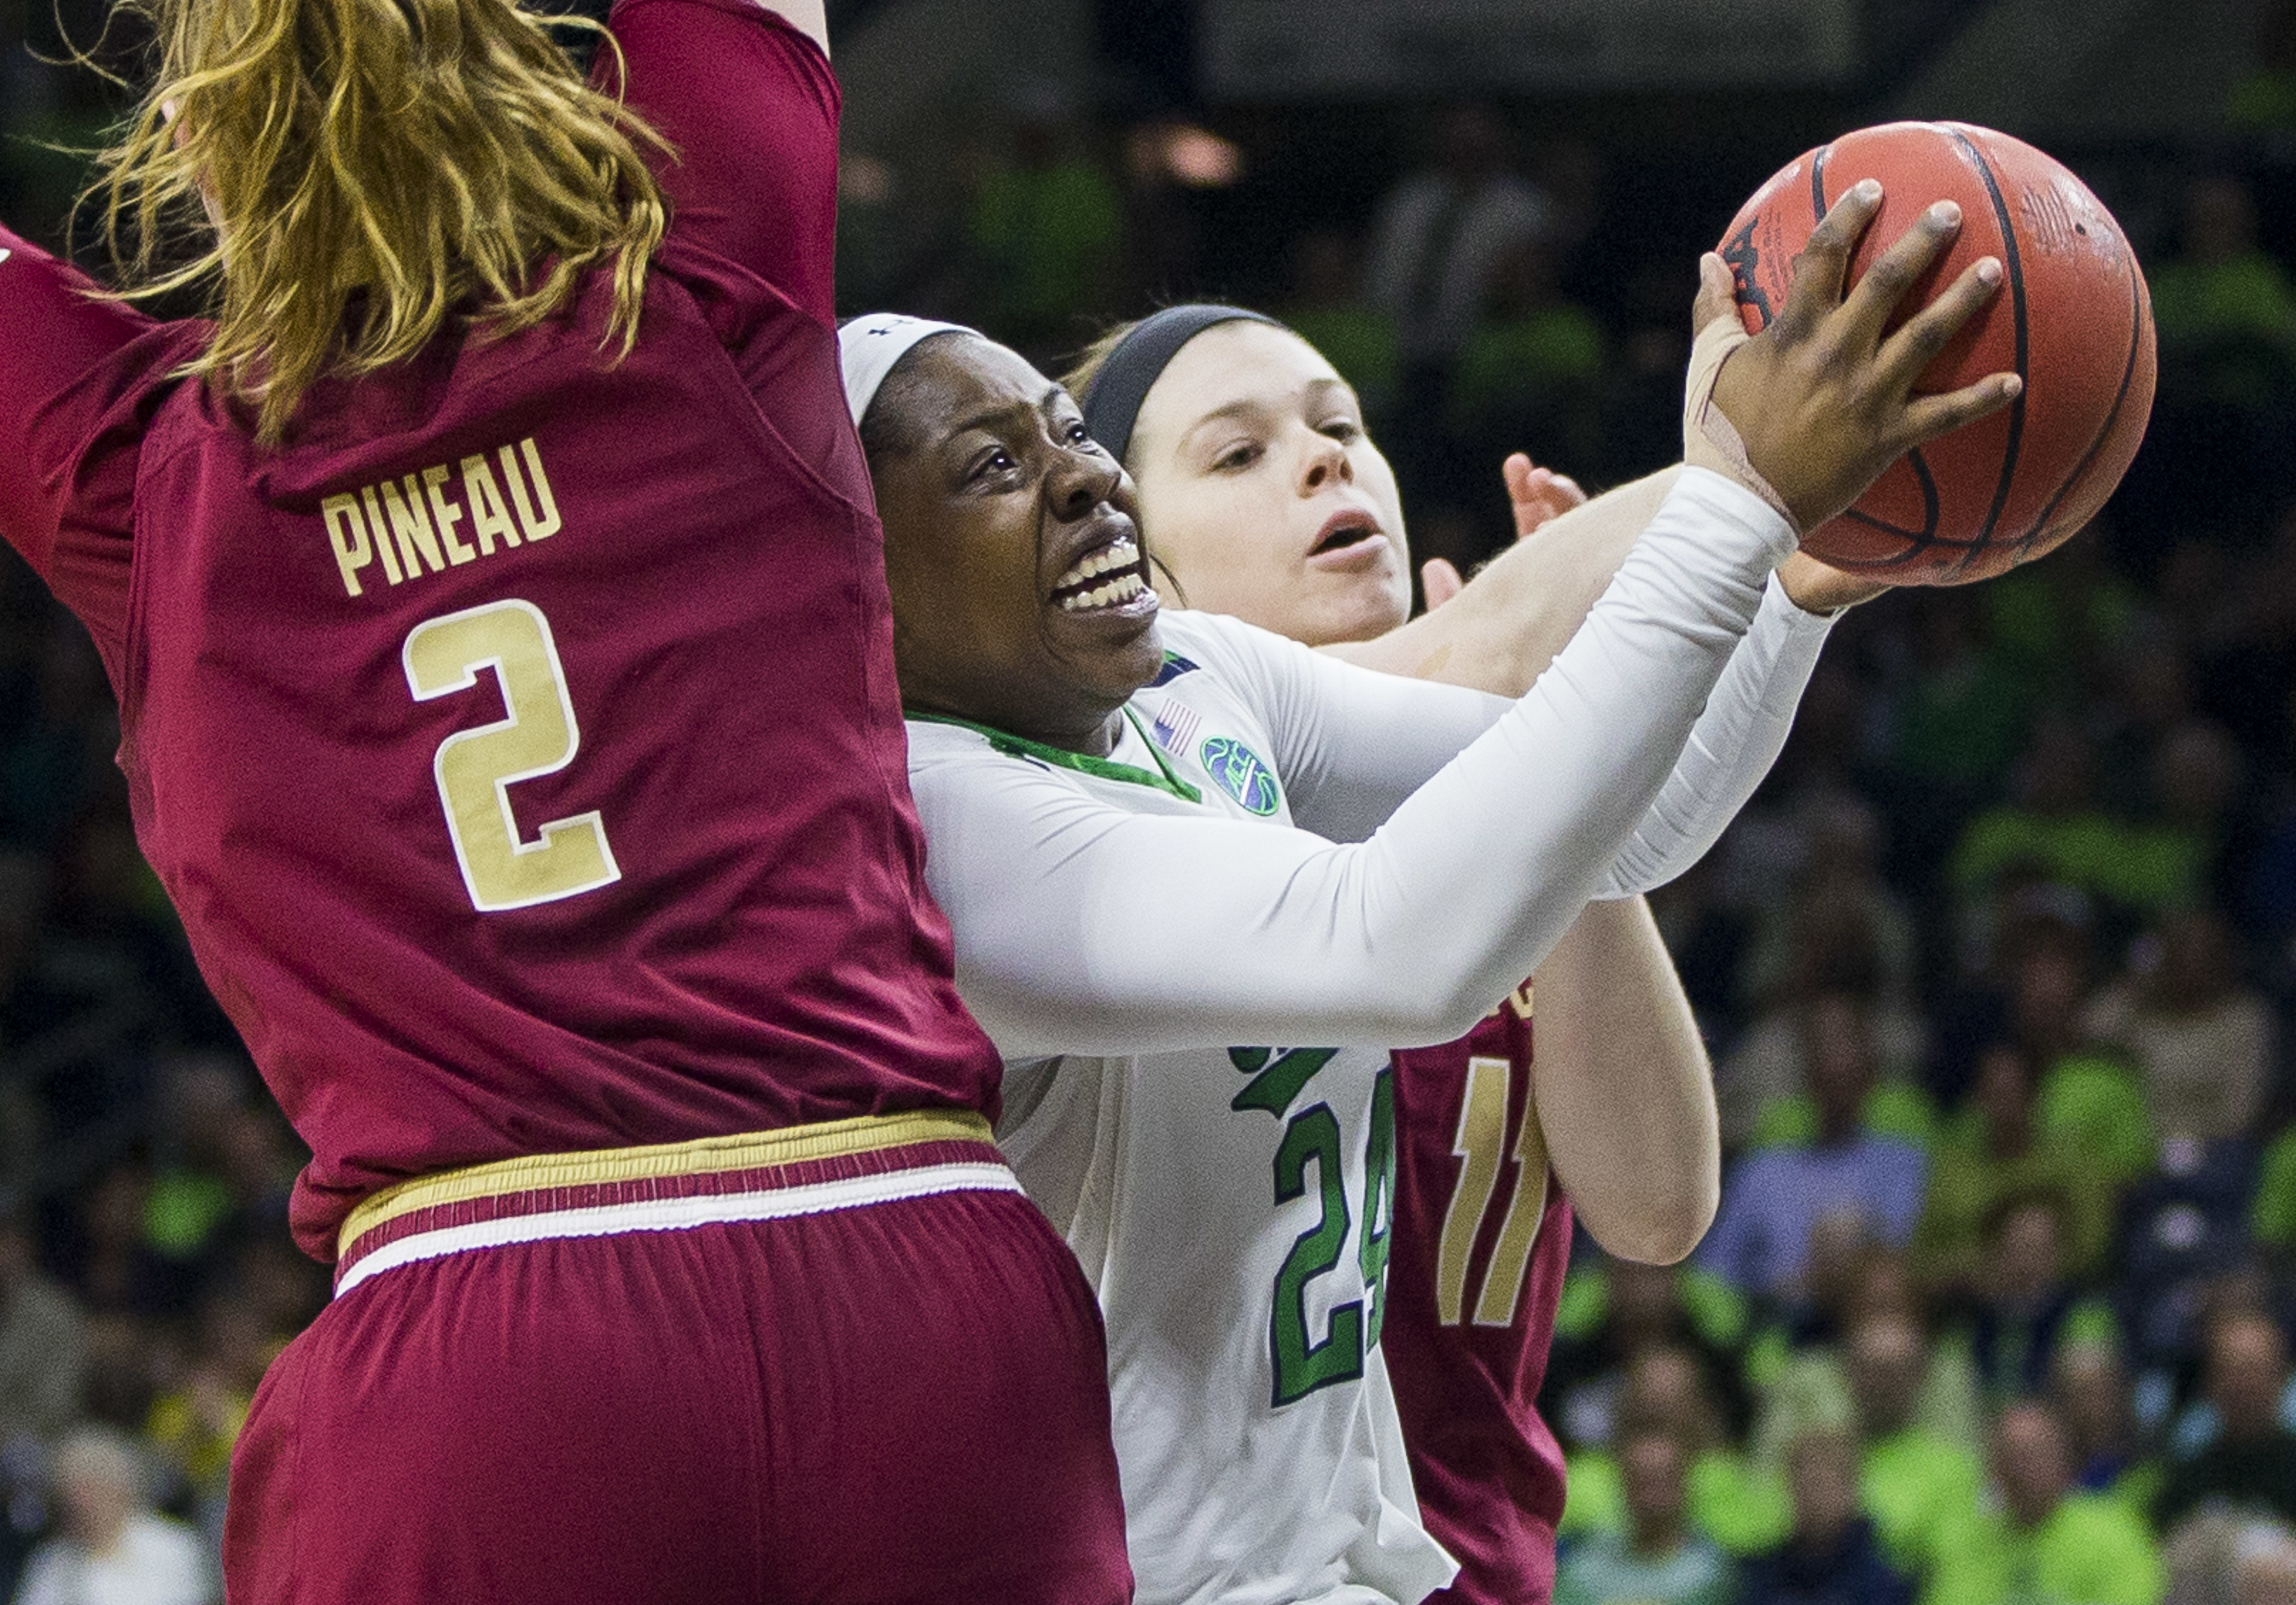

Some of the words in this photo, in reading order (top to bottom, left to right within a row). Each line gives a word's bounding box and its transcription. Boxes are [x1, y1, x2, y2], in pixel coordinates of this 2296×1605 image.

[321, 438, 562, 597] PINEAU
[402, 598, 622, 912] 2
[1435, 1055, 1550, 1328] 11
